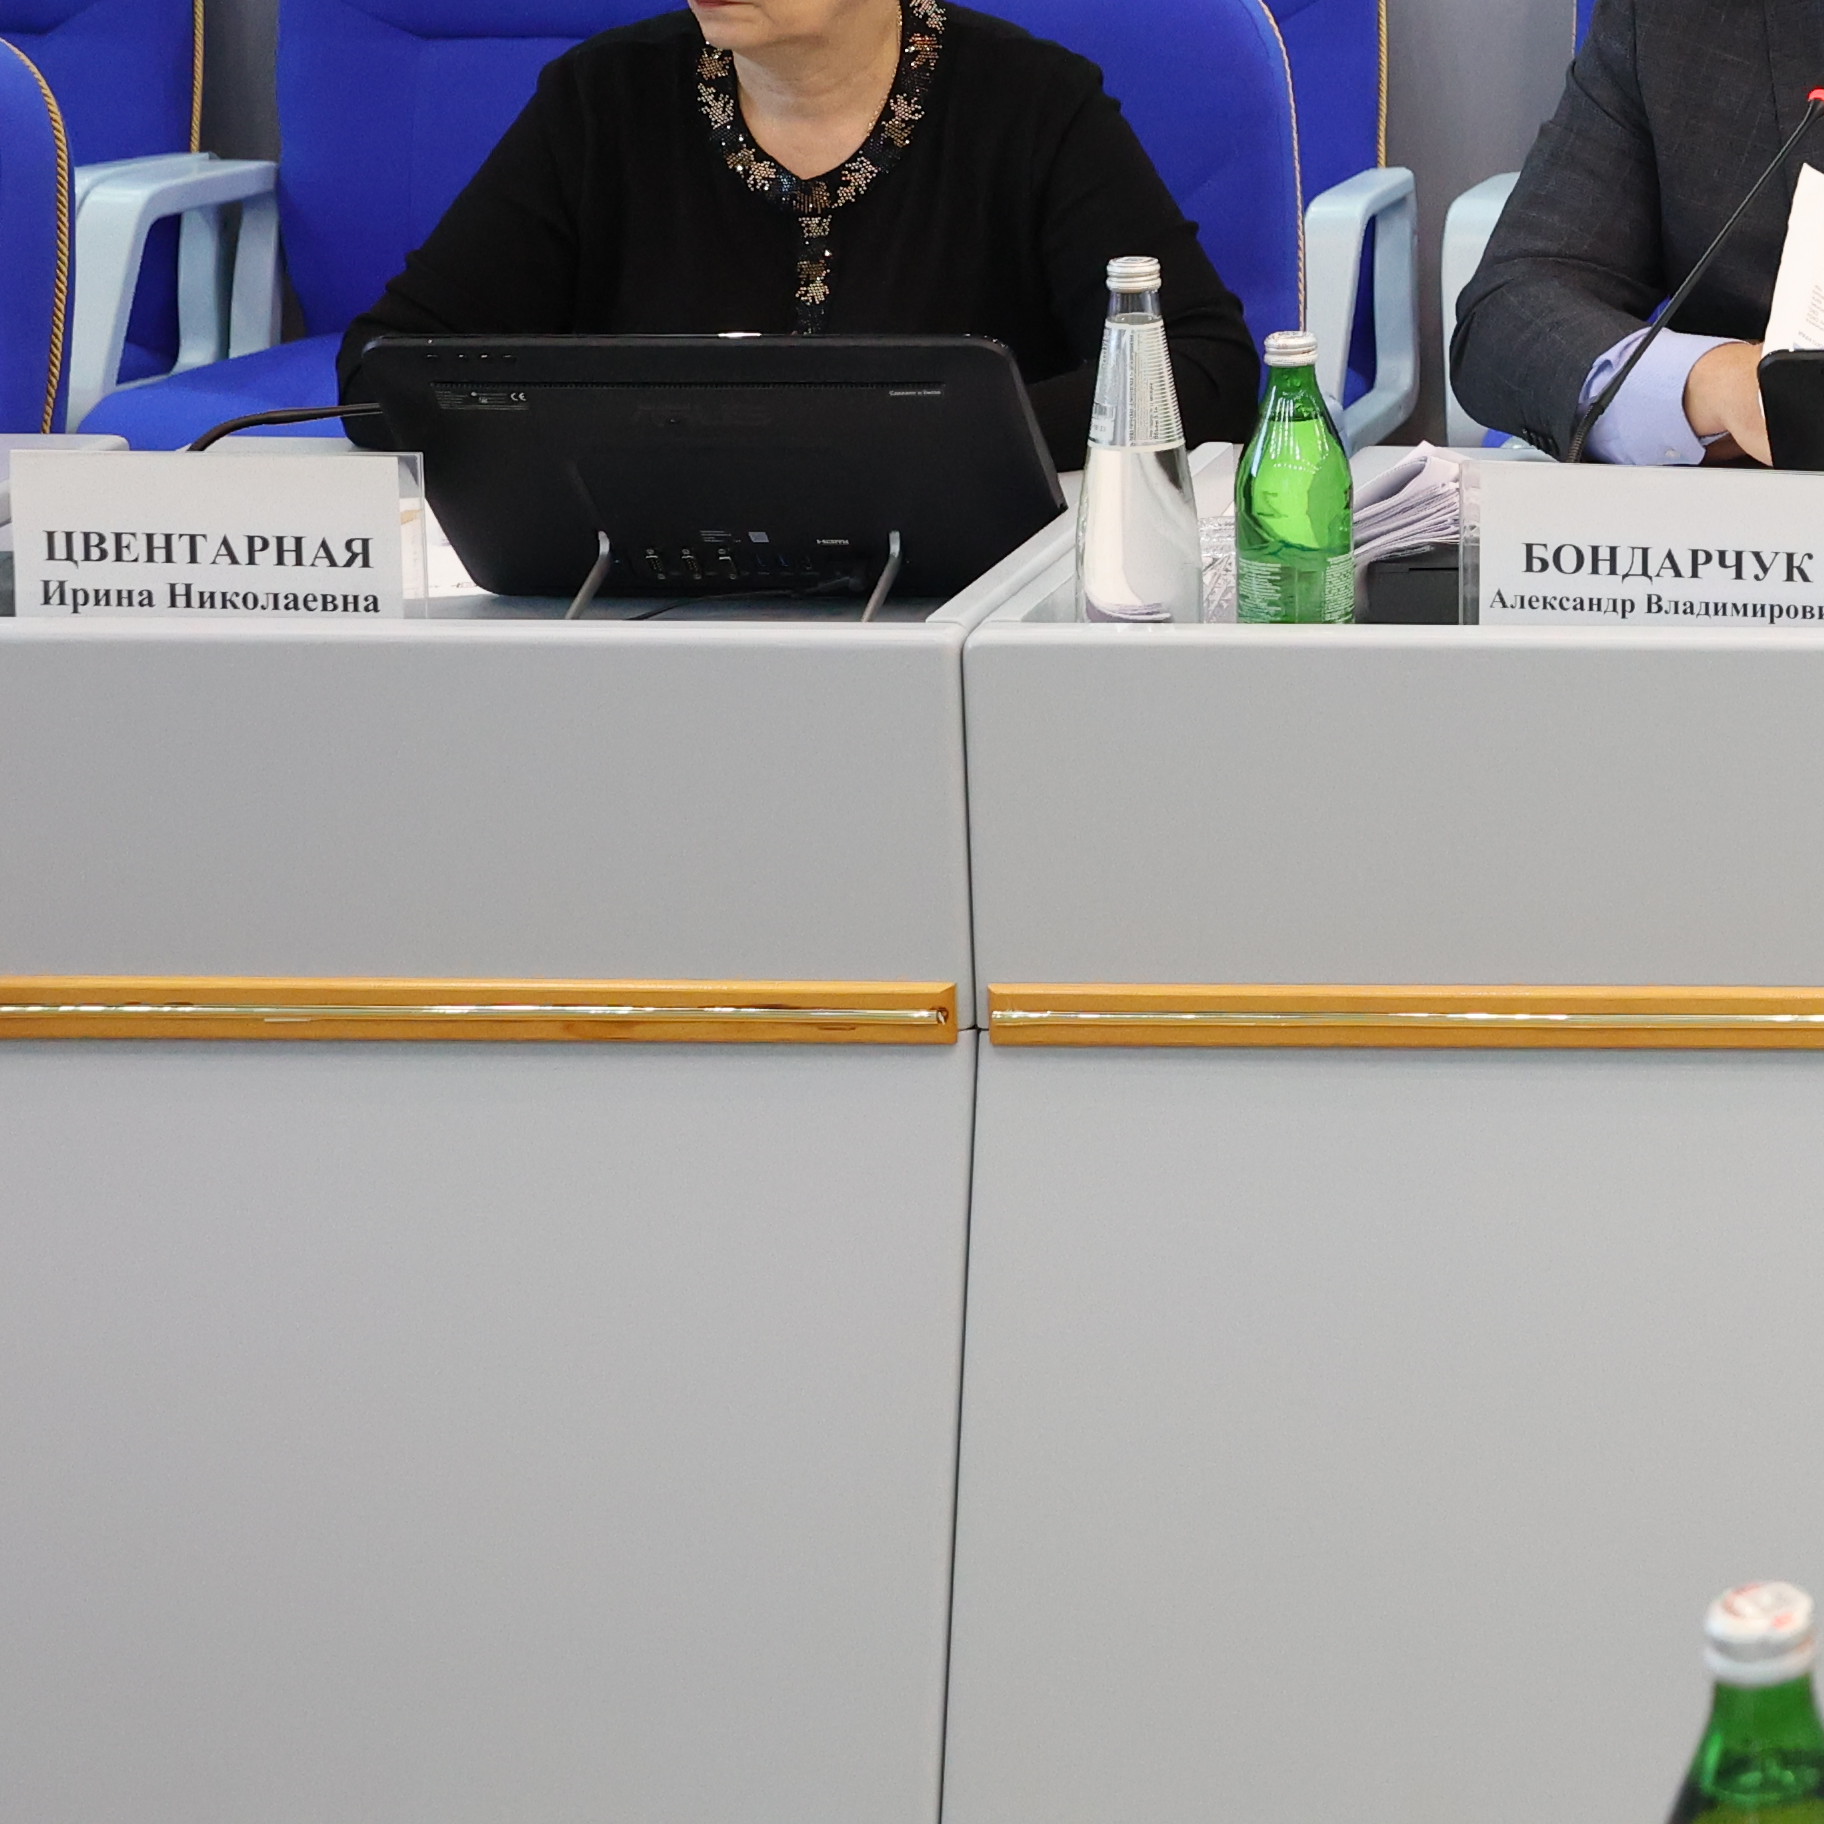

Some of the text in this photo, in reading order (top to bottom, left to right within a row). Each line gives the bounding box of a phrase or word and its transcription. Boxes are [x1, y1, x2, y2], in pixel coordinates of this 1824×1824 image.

[43, 529, 374, 570] ЦВЕНТАРНАЯ
[1521, 542, 1815, 584] БОНДАРЧУК
[41, 579, 382, 614] Ирина Николаевна
[1489, 588, 1636, 615] Александр
